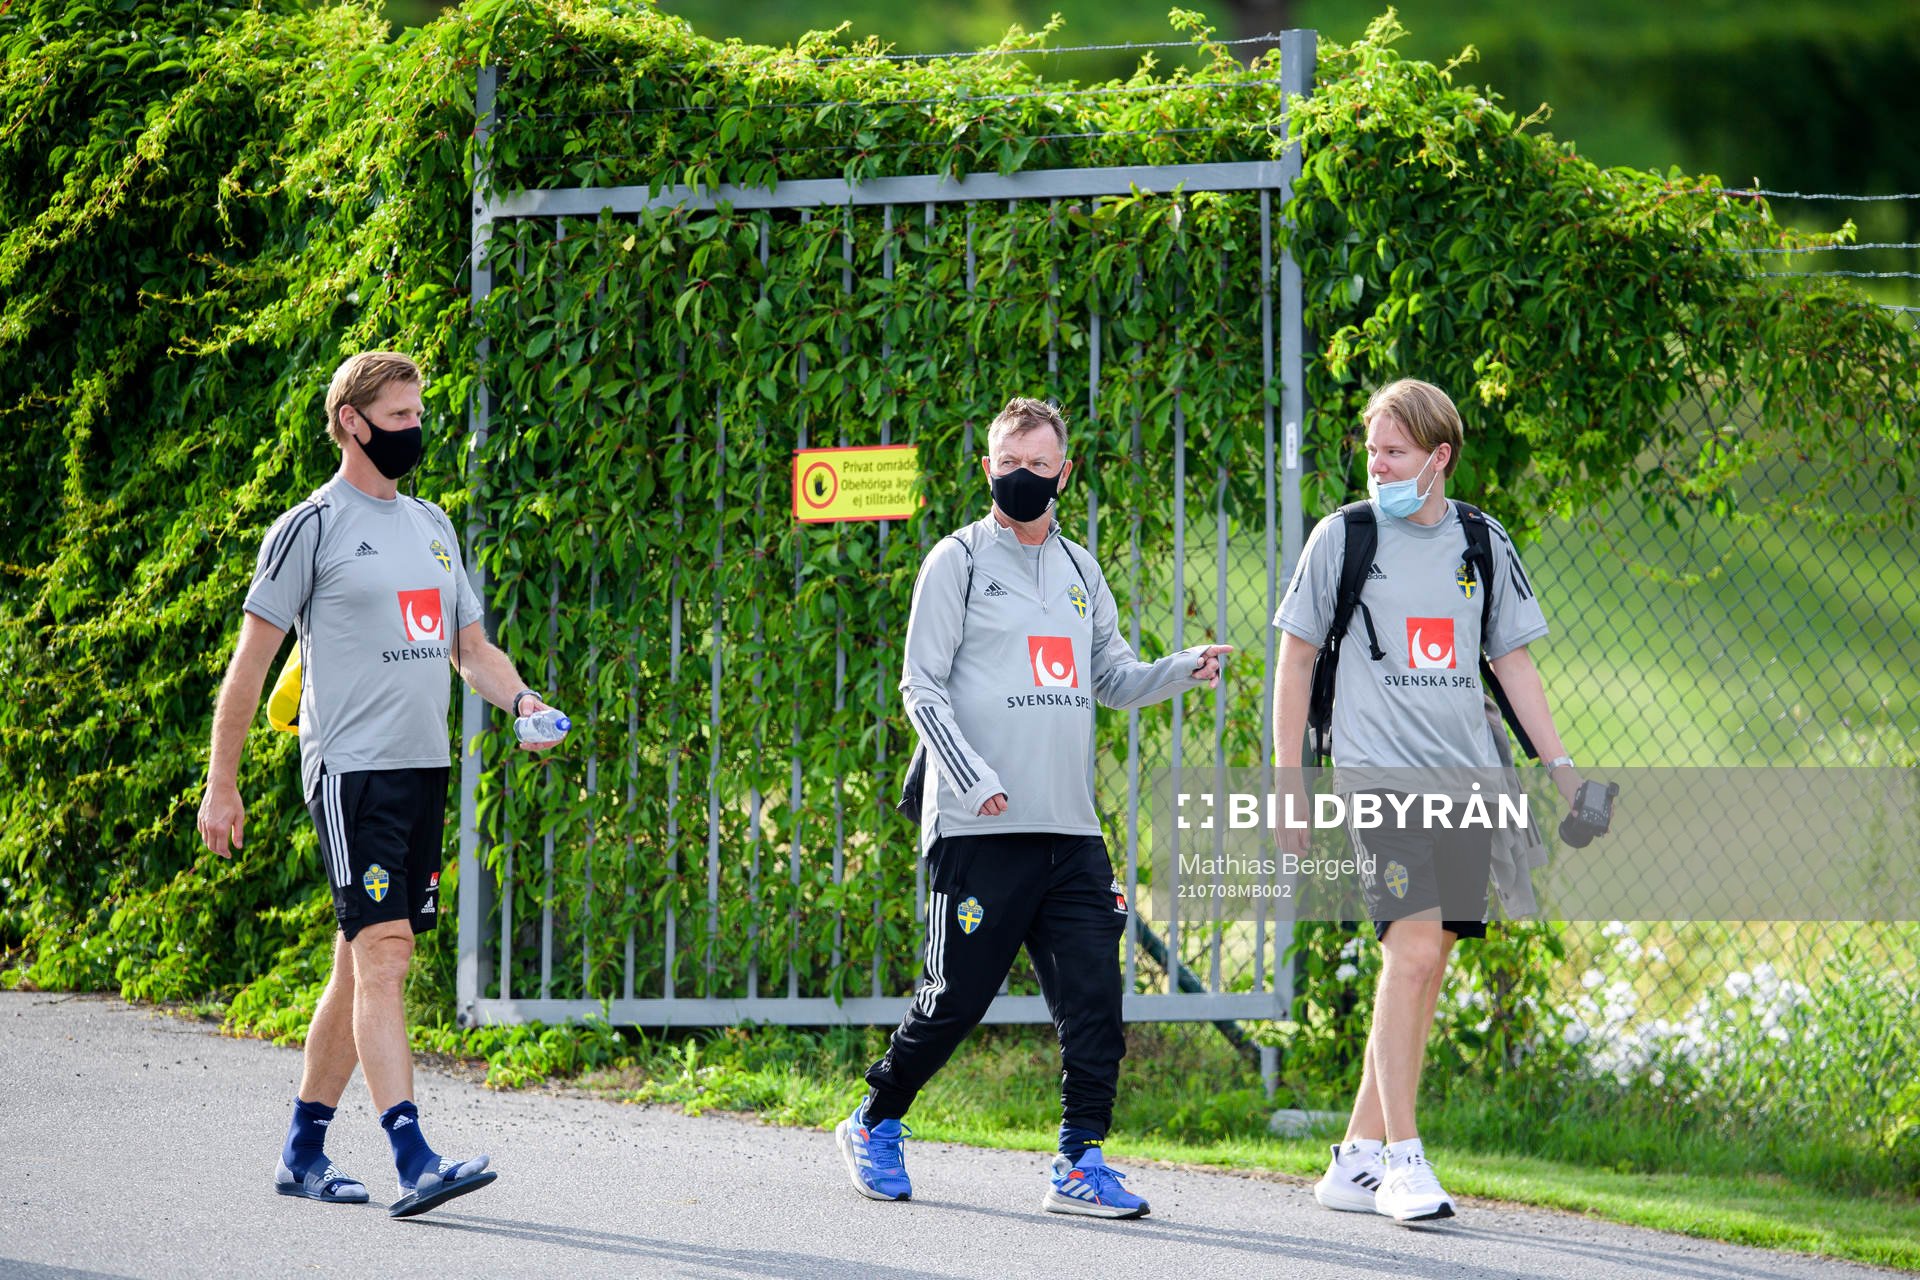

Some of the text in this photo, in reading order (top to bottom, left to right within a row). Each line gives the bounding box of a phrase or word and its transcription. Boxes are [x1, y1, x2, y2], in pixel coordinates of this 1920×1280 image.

[843, 460, 873, 472] Privat
[841, 478, 892, 491] Obehöriga
[853, 492, 906, 508] ej tillträde
[382, 647, 441, 662] SVENSKA
[1385, 675, 1476, 689] SVENSKA SPEL
[1007, 694, 1072, 708] SVENSKA
